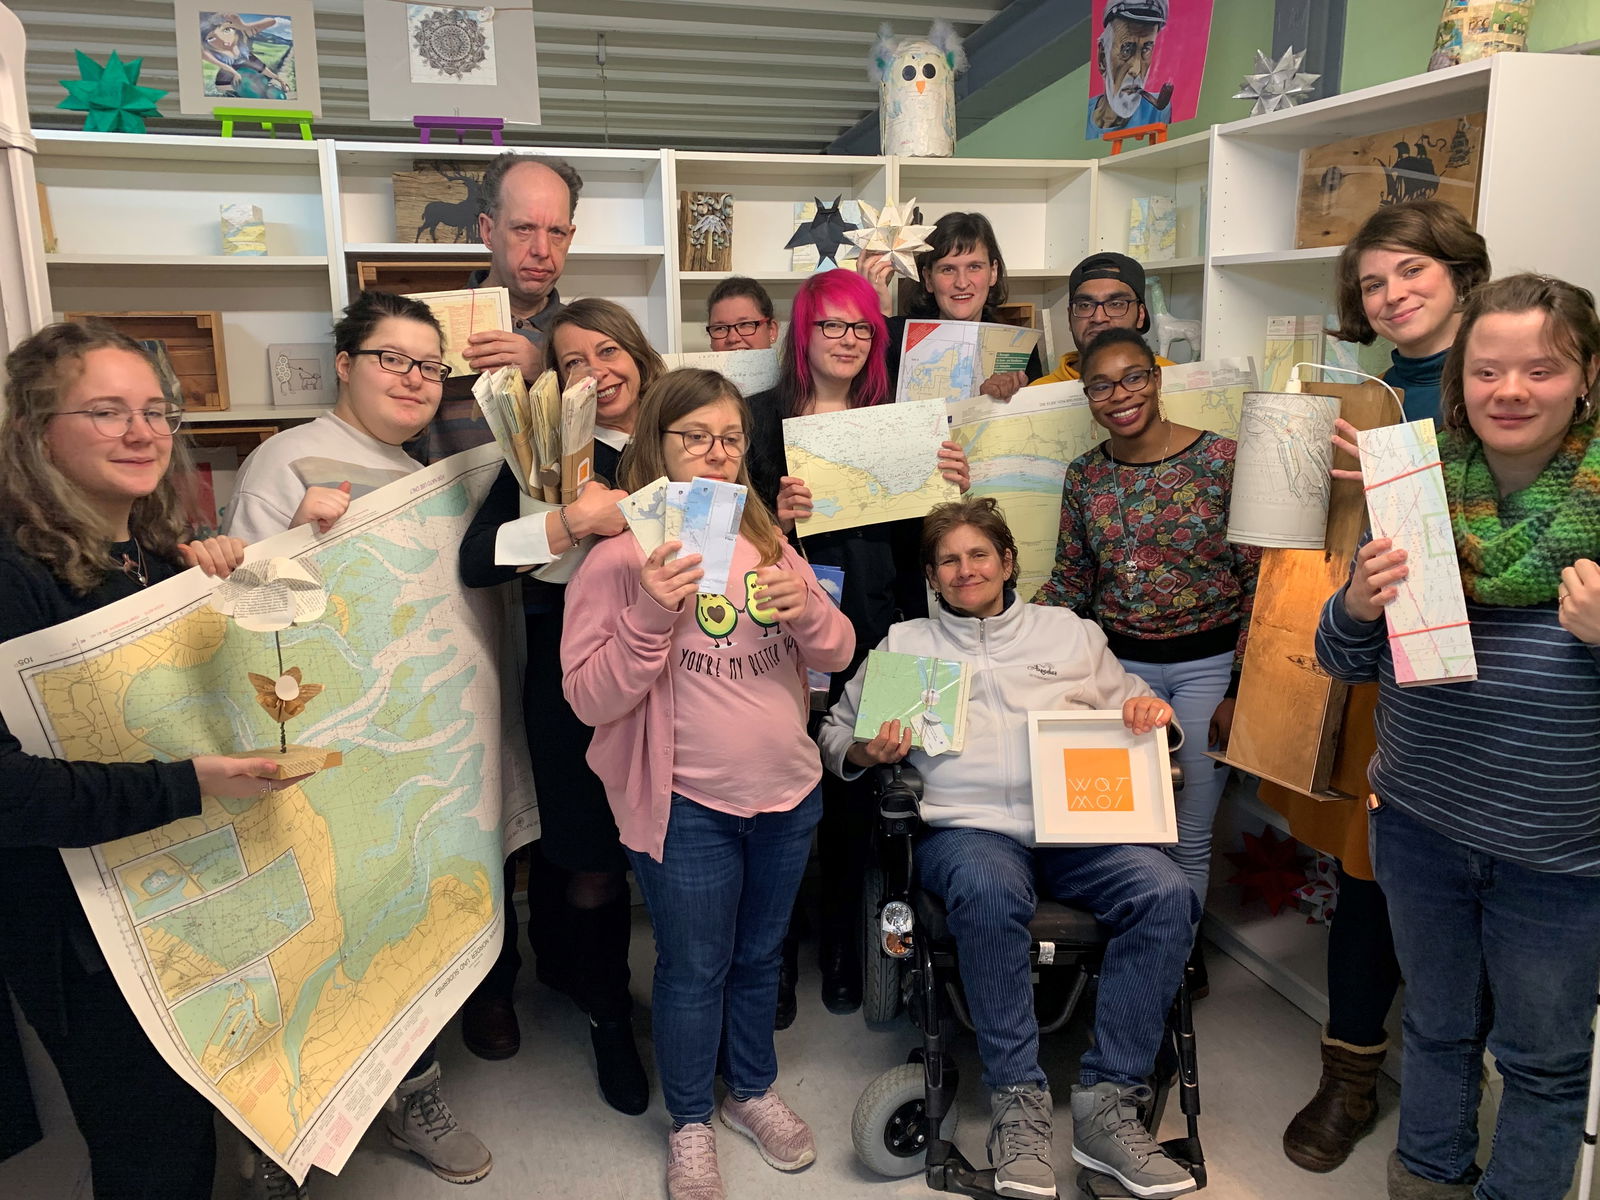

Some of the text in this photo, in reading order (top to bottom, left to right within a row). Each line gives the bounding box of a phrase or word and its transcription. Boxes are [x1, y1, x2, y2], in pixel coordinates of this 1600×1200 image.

[18, 657, 34, 666] 105
[679, 648, 721, 678] YOU'RE
[729, 656, 743, 680] MY
[748, 643, 781, 677] BETTER
[471, 938, 490, 960] NORDER
[459, 957, 471, 972] UND
